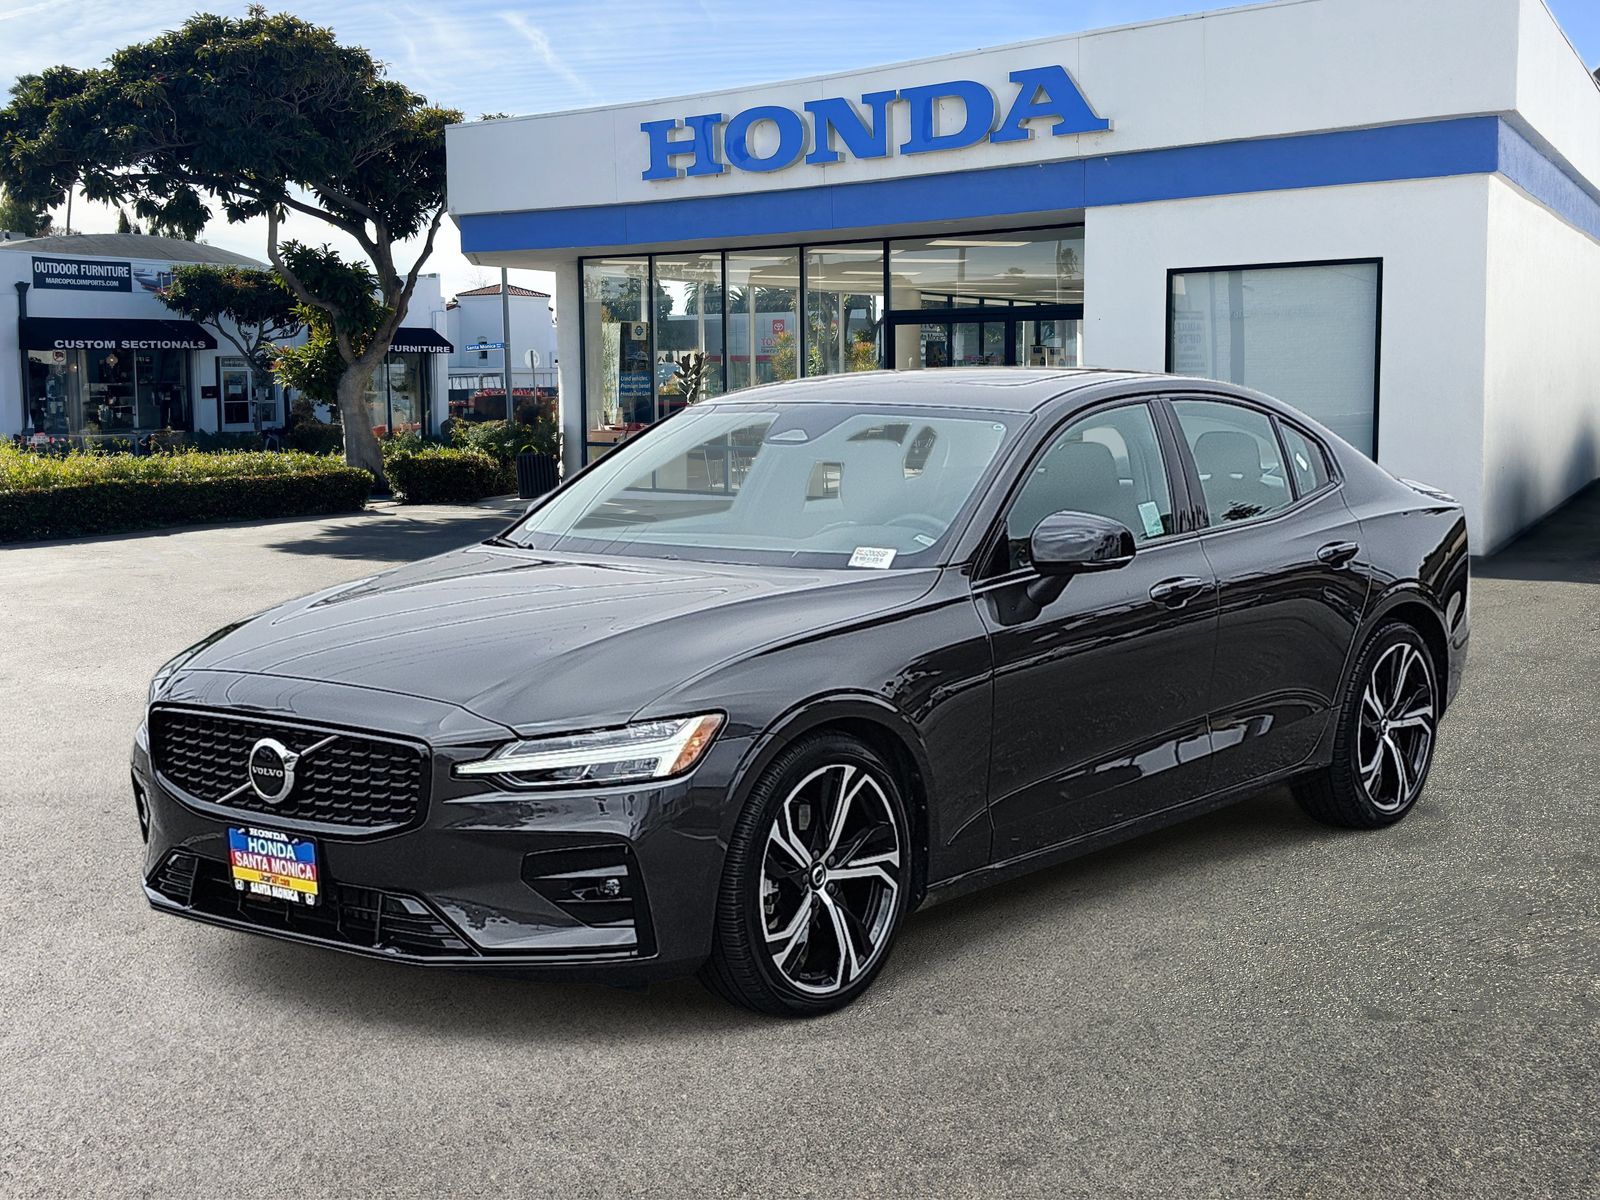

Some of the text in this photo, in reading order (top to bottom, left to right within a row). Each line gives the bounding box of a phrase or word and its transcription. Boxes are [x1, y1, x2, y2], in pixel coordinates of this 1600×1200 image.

[640, 65, 1111, 181] HONDA
[34, 261, 130, 278] OUTDOOR FURNITURE
[46, 277, 119, 287] MARCOPOLOIMPORTS.COM
[54, 339, 206, 349] CUSTOM SECTIONALS
[388, 345, 451, 353] FURNITURE
[252, 766, 283, 777] VOLVO
[249, 827, 289, 842] HONDA
[247, 837, 296, 860] HONDA
[234, 851, 270, 872] SANTA
[271, 857, 313, 880] MONICA
[250, 882, 299, 902] SANTA MONICA
